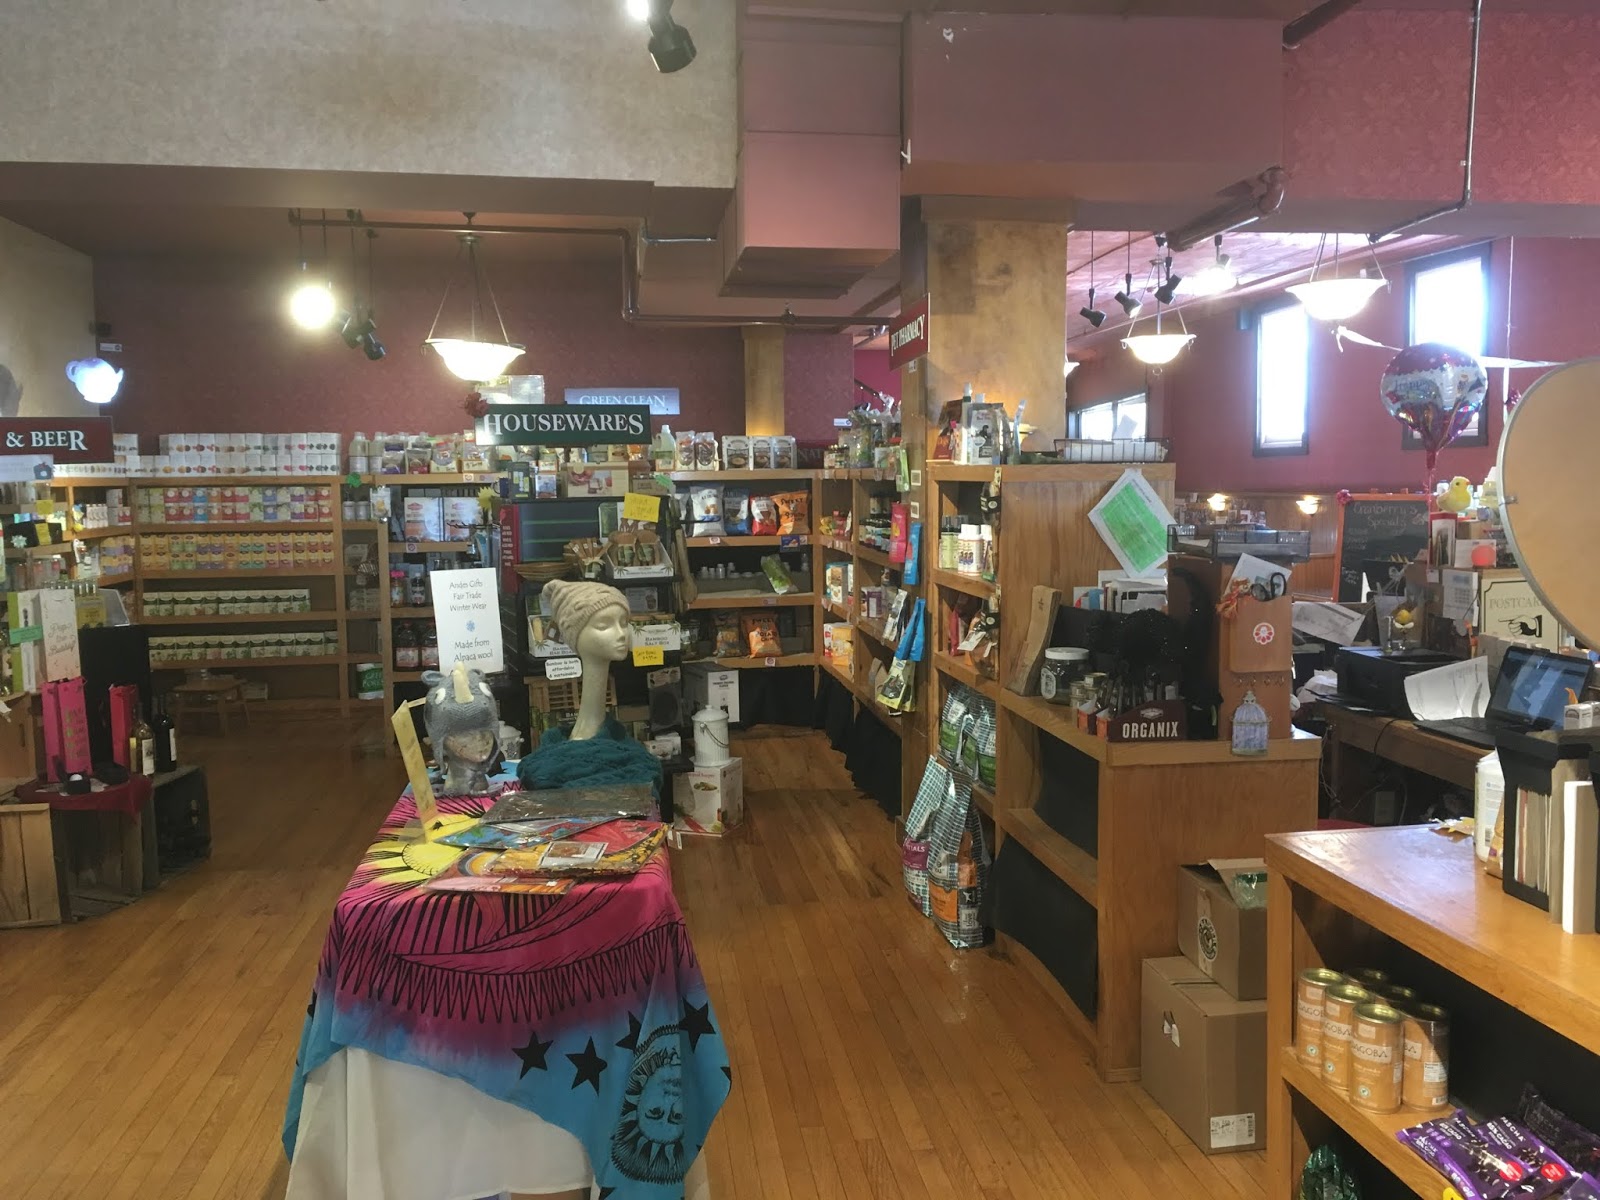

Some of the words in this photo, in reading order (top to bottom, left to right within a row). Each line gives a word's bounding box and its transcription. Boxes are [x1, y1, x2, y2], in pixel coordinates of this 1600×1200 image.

[891, 331, 899, 357] PET
[899, 314, 925, 347] PHARMACY
[579, 395, 622, 405] GREEN
[624, 395, 666, 407] CLEAN
[484, 413, 644, 436] HOUSEWARES
[6, 431, 25, 448] &
[30, 430, 88, 451] BEER
[448, 582, 468, 590] Andes
[469, 578, 483, 588] Gifts
[465, 592, 482, 600] Trade
[449, 604, 471, 612] Winter
[454, 640, 473, 650] Made
[474, 637, 490, 647] from
[453, 652, 477, 662] Alpaca
[477, 649, 493, 660] wool
[1122, 721, 1179, 739] ORGANIX
[1500, 1116, 1524, 1142] PASCHA
